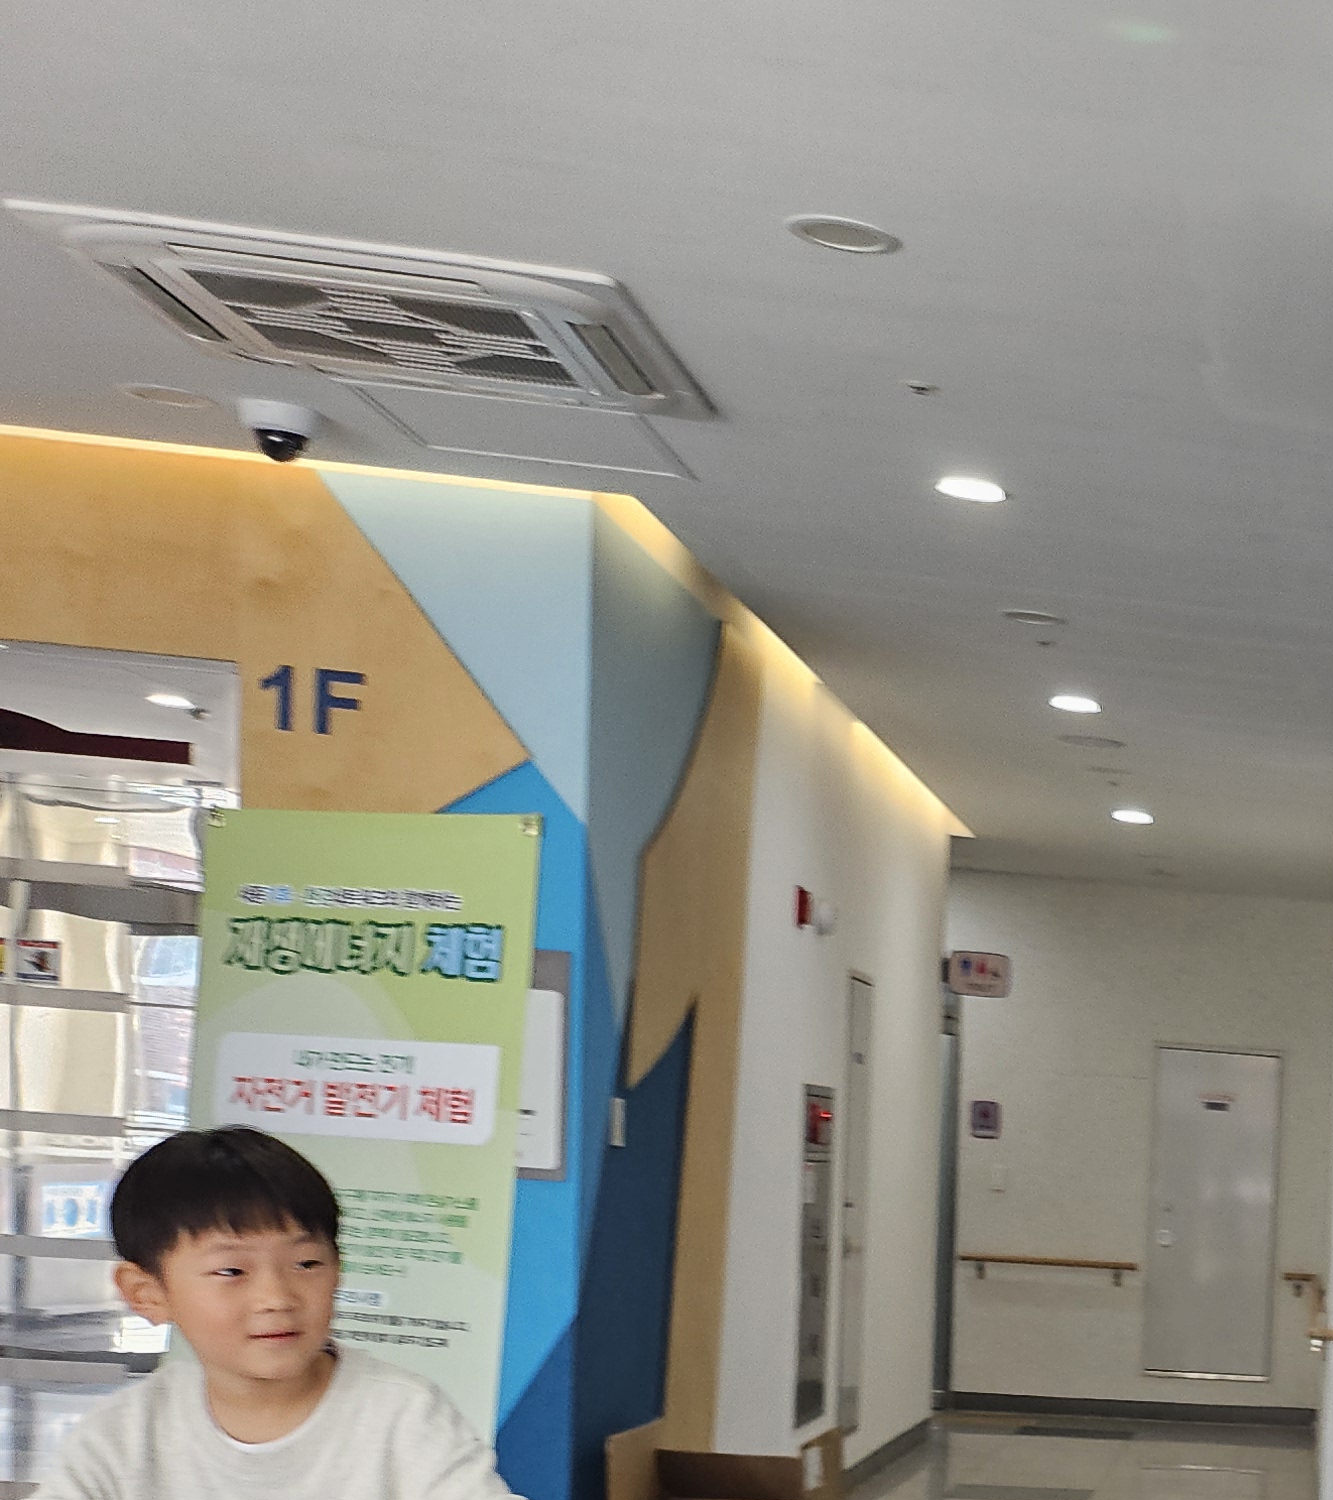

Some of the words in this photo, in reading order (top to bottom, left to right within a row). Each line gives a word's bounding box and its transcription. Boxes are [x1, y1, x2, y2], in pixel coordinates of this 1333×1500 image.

[259, 664, 366, 734] 1F
[222, 916, 416, 977] 재생에너지
[419, 922, 504, 983] 체험
[231, 1076, 314, 1115] 자전거
[323, 1081, 409, 1121] 발전기
[415, 1086, 475, 1125] 체험
